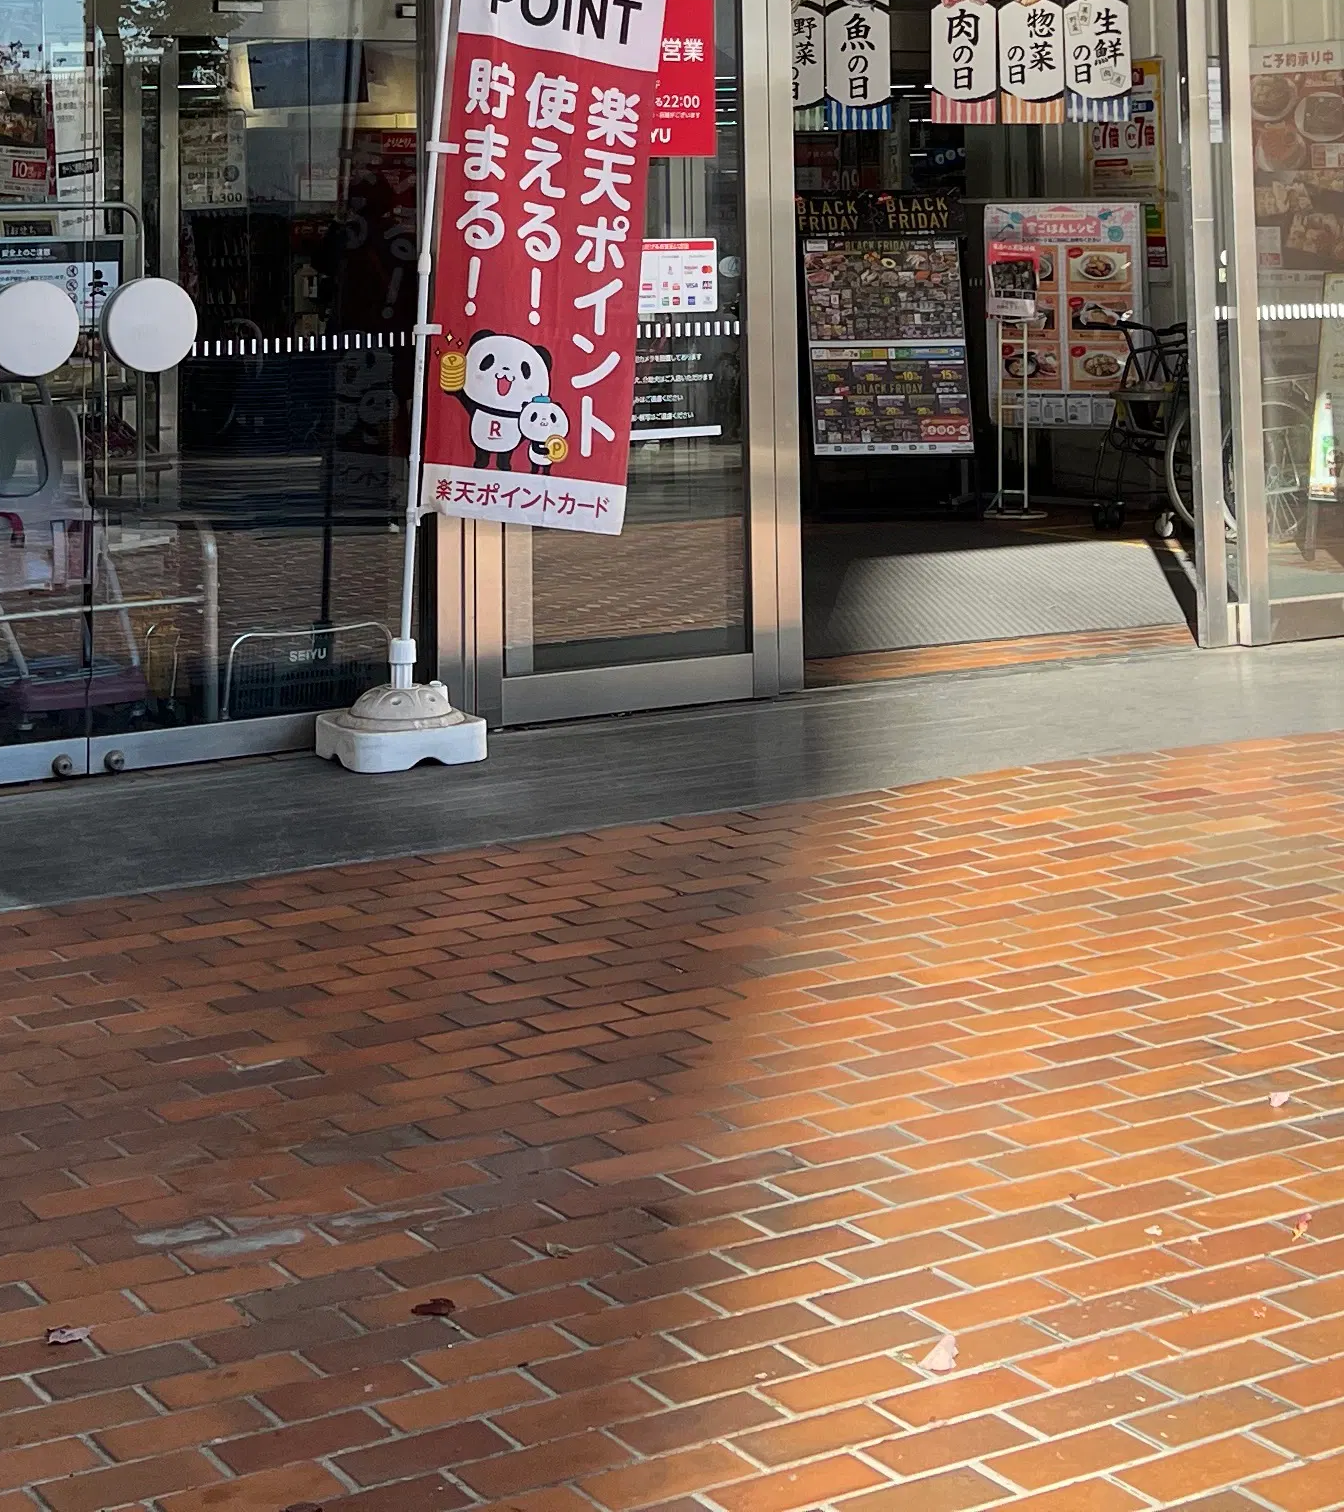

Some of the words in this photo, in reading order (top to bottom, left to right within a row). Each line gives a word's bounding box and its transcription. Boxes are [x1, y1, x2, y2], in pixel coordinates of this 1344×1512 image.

[947, 9, 980, 90] 肉の日
[1027, 8, 1056, 72] 惣菜
[1094, 8, 1124, 67] 生鮮
[840, 13, 875, 100] 魚の日
[1008, 45, 1026, 85] の日
[1073, 45, 1092, 84] の日
[1263, 50, 1333, 68] ご予約承り中
[796, 200, 858, 215] BLACK
[886, 197, 948, 213] BLACK
[798, 215, 859, 231] FRIDAY
[887, 212, 950, 229] FRIDAY
[845, 241, 875, 251] BLACK
[877, 240, 910, 251] FRIDAY
[570, 84, 641, 458] 楽天ポイント
[857, 383, 887, 394] BLACK
[890, 383, 923, 394] FRIDAY
[435, 478, 610, 519] 楽天ポイントカード
[289, 648, 327, 662] SEIYU
